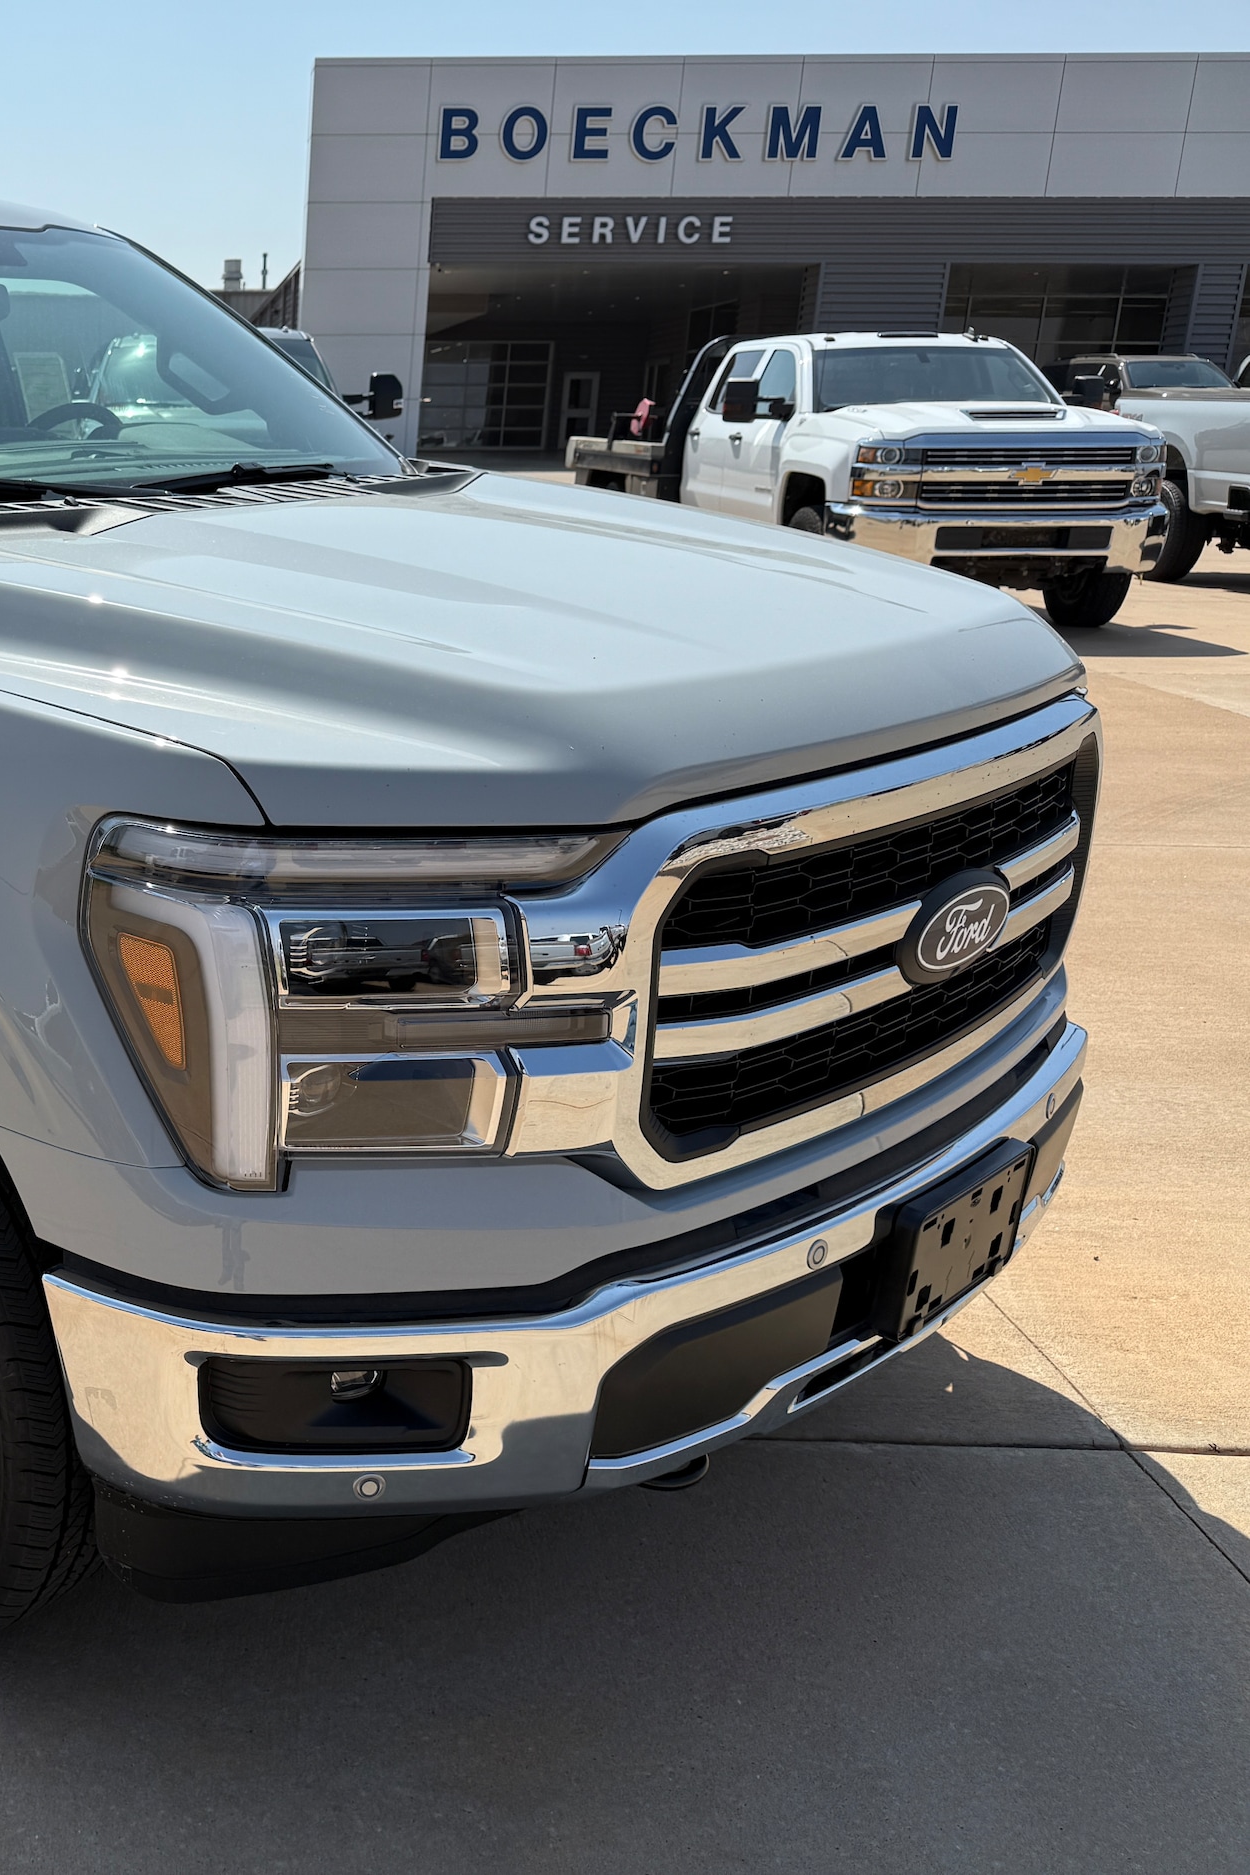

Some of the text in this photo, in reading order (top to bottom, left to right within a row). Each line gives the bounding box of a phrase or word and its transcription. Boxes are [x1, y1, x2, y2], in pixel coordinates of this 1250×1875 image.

[437, 104, 960, 162] BOECKMAN
[527, 215, 734, 244] SERVICE
[936, 898, 996, 961] Ford
